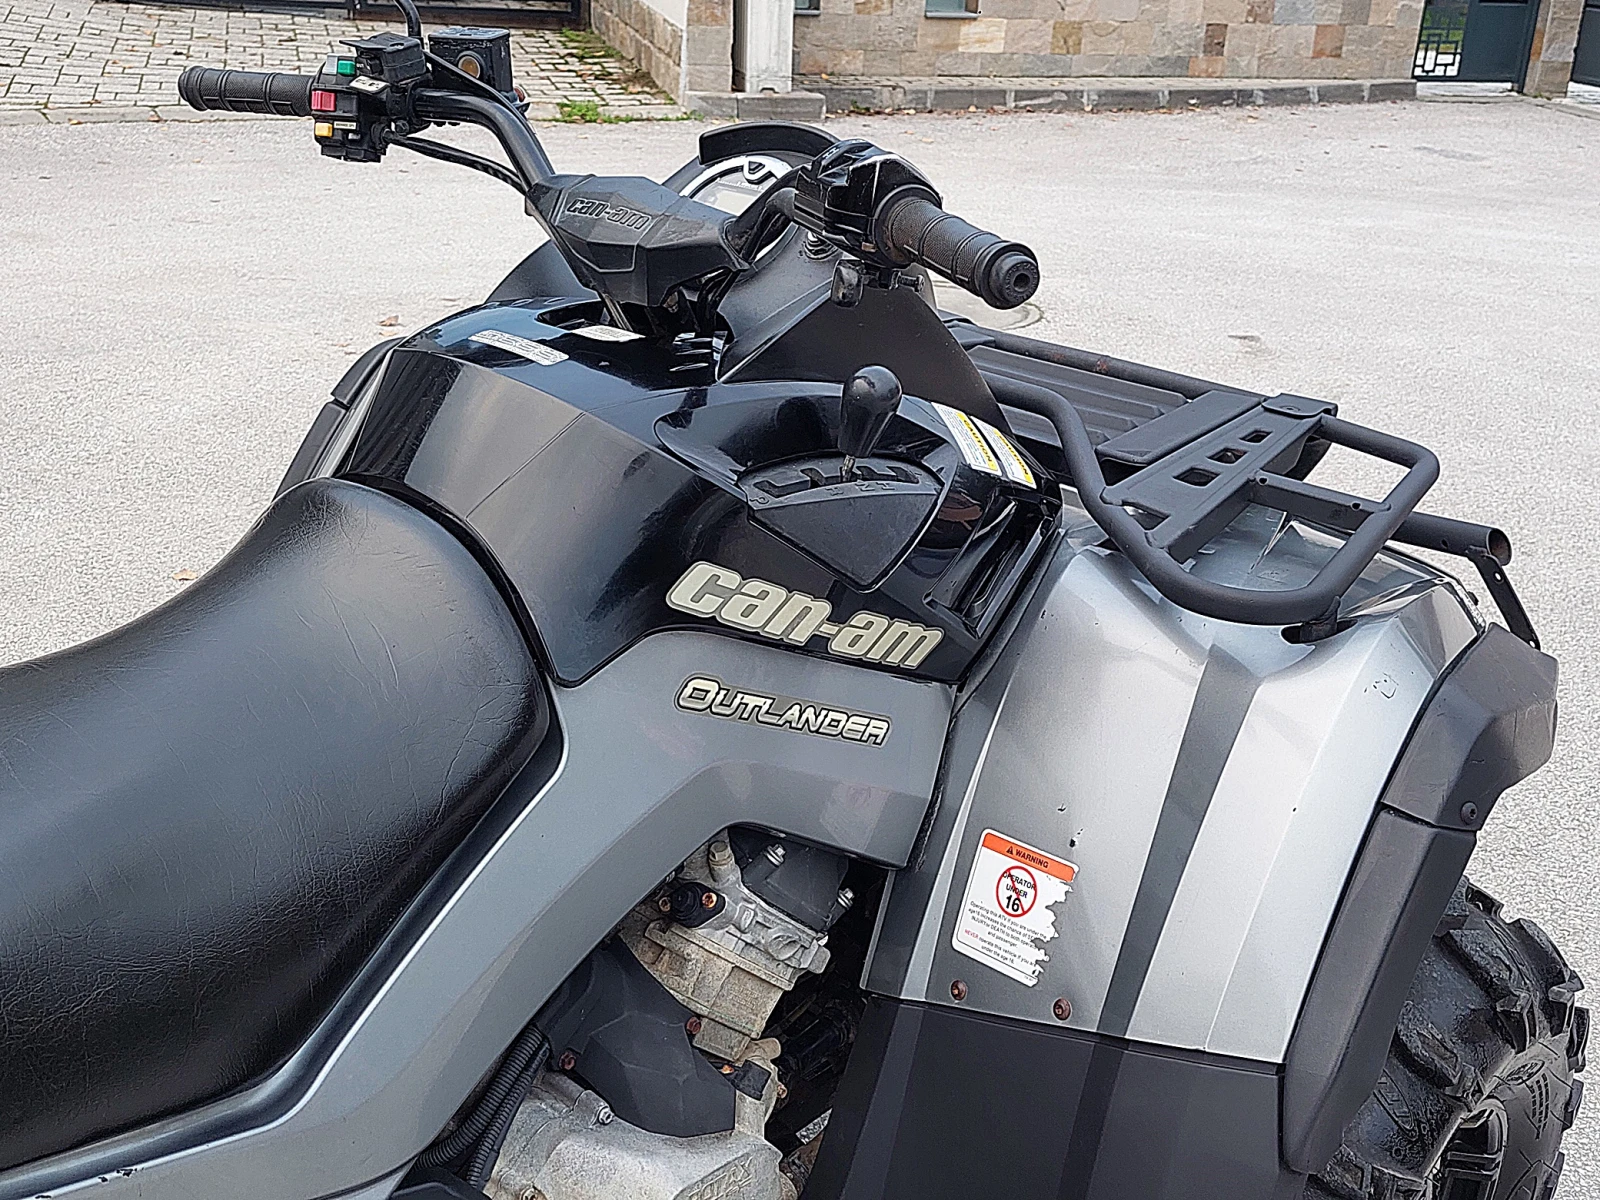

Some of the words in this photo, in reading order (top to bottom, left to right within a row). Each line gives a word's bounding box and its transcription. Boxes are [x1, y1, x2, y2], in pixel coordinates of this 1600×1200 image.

[566, 198, 650, 230] can-am
[964, 420, 992, 462] CAUTION
[669, 562, 943, 668] can-am
[1015, 848, 1049, 868] WARNING
[1003, 871, 1036, 891] OPERATOR
[1006, 883, 1028, 898] UNDER
[1006, 894, 1021, 912] 16
[970, 901, 989, 914] Operating
[1027, 926, 1039, 935] under
[981, 912, 999, 925] increases
[1007, 925, 1022, 935] chance
[990, 925, 1005, 935] DEATH
[964, 929, 979, 939] NEVER
[979, 937, 994, 947] operate
[994, 943, 1002, 951] this
[1002, 947, 1017, 958] vehicle
[981, 945, 993, 953] under
